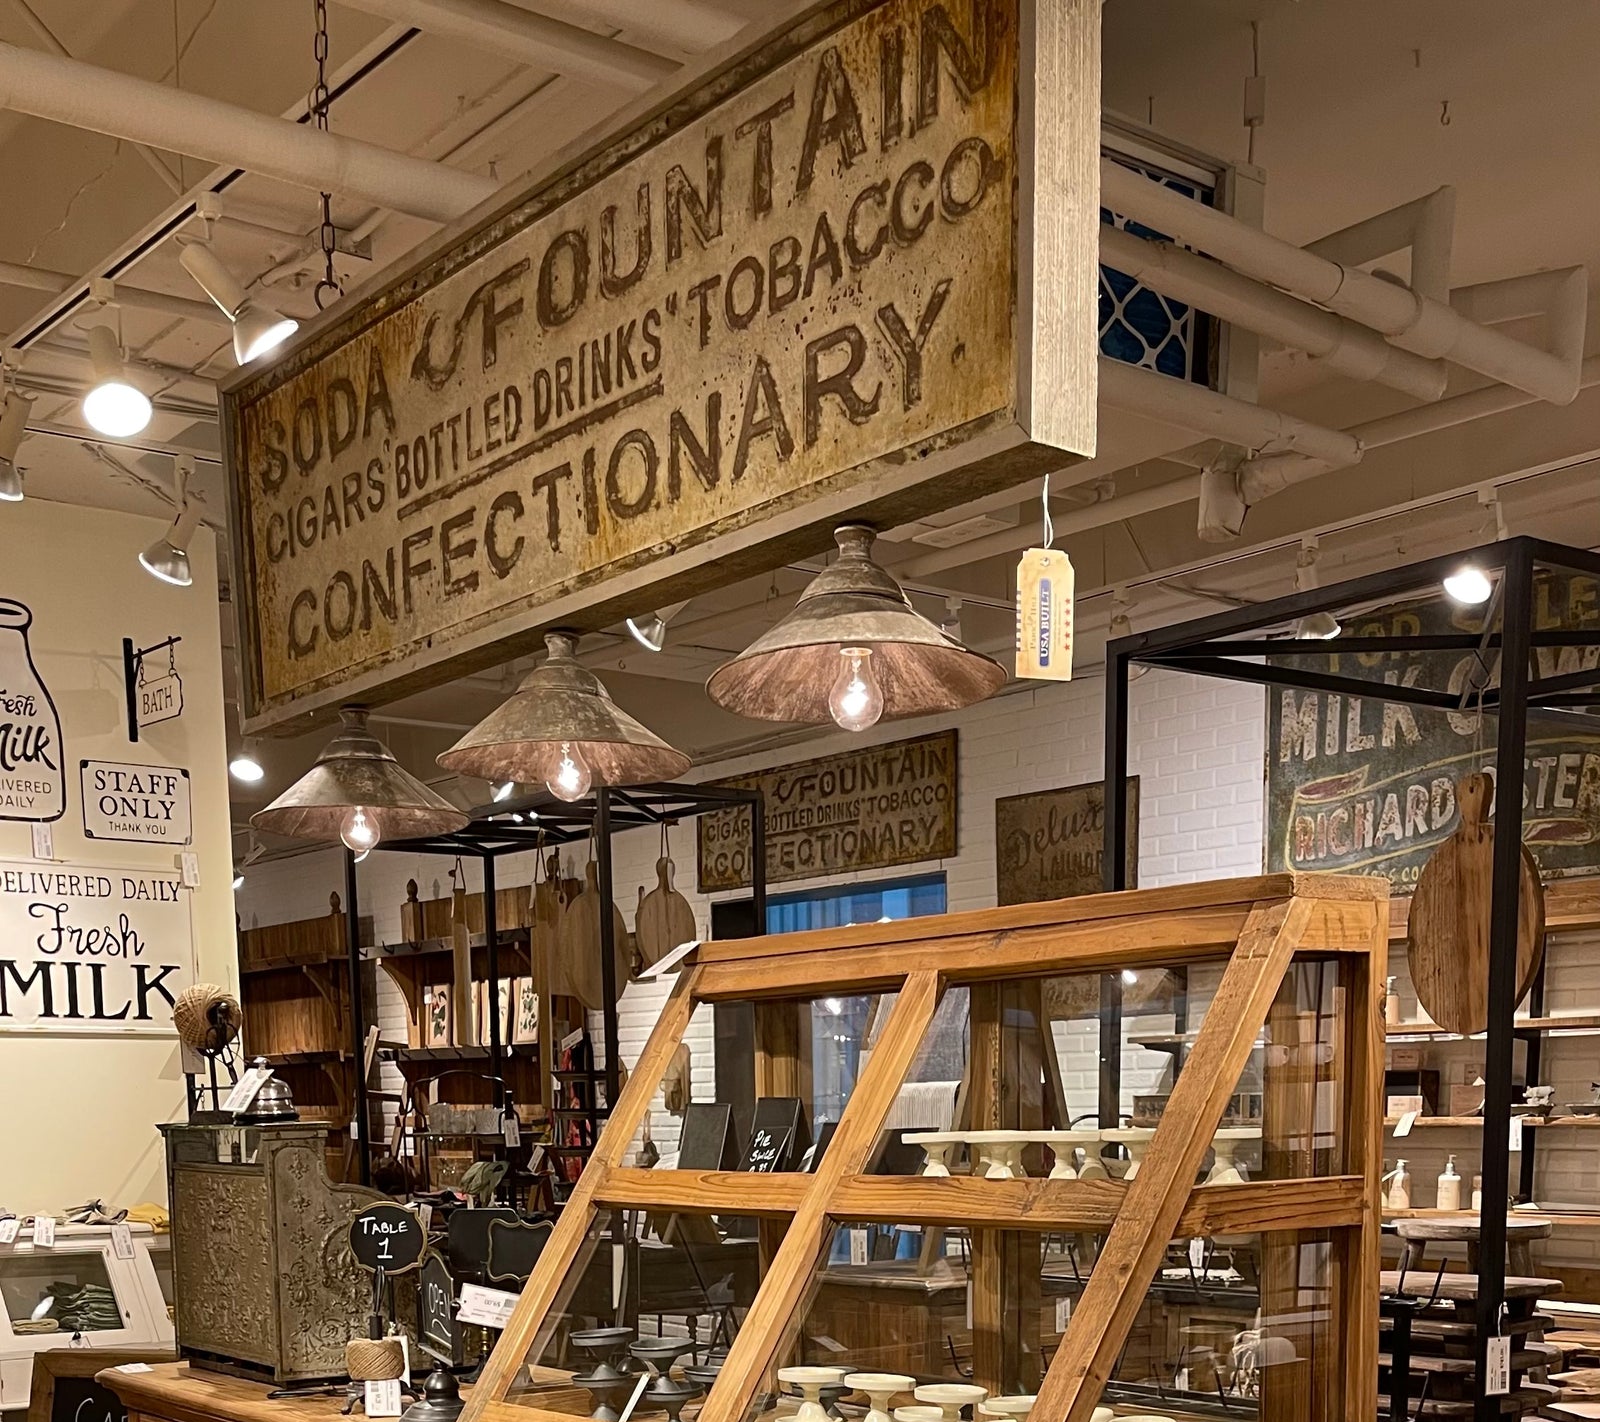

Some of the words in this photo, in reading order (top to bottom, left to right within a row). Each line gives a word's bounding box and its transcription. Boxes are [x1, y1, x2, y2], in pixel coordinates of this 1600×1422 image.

[260, 343, 396, 497] SODA
[410, 0, 1003, 381] FOUNTAIN
[395, 389, 522, 500] BOTTLED
[286, 278, 954, 662] CONFECTIONARY
[1040, 590, 1050, 630] BUILT
[1040, 632, 1050, 657] USA
[142, 685, 173, 715] BATH
[1280, 664, 1422, 764] MILK
[0, 779, 52, 794] IVERED
[94, 769, 178, 797] STAFF
[771, 745, 949, 804] FOUNTAIN
[99, 796, 176, 821] ONLY
[706, 818, 751, 842] CIGAR
[765, 806, 814, 833] BOTTLED
[1294, 776, 1456, 862] RICHARD
[109, 821, 142, 835] THANK
[146, 823, 167, 836] YOU
[1006, 804, 1104, 872] Delux
[0, 870, 112, 899] ELIVERED
[122, 878, 181, 902] DAILY
[28, 902, 145, 959] Fresh
[0, 960, 181, 1021] MILK
[753, 1129, 772, 1148] PIE
[359, 1216, 409, 1236] TABLE
[376, 1237, 393, 1259] 1
